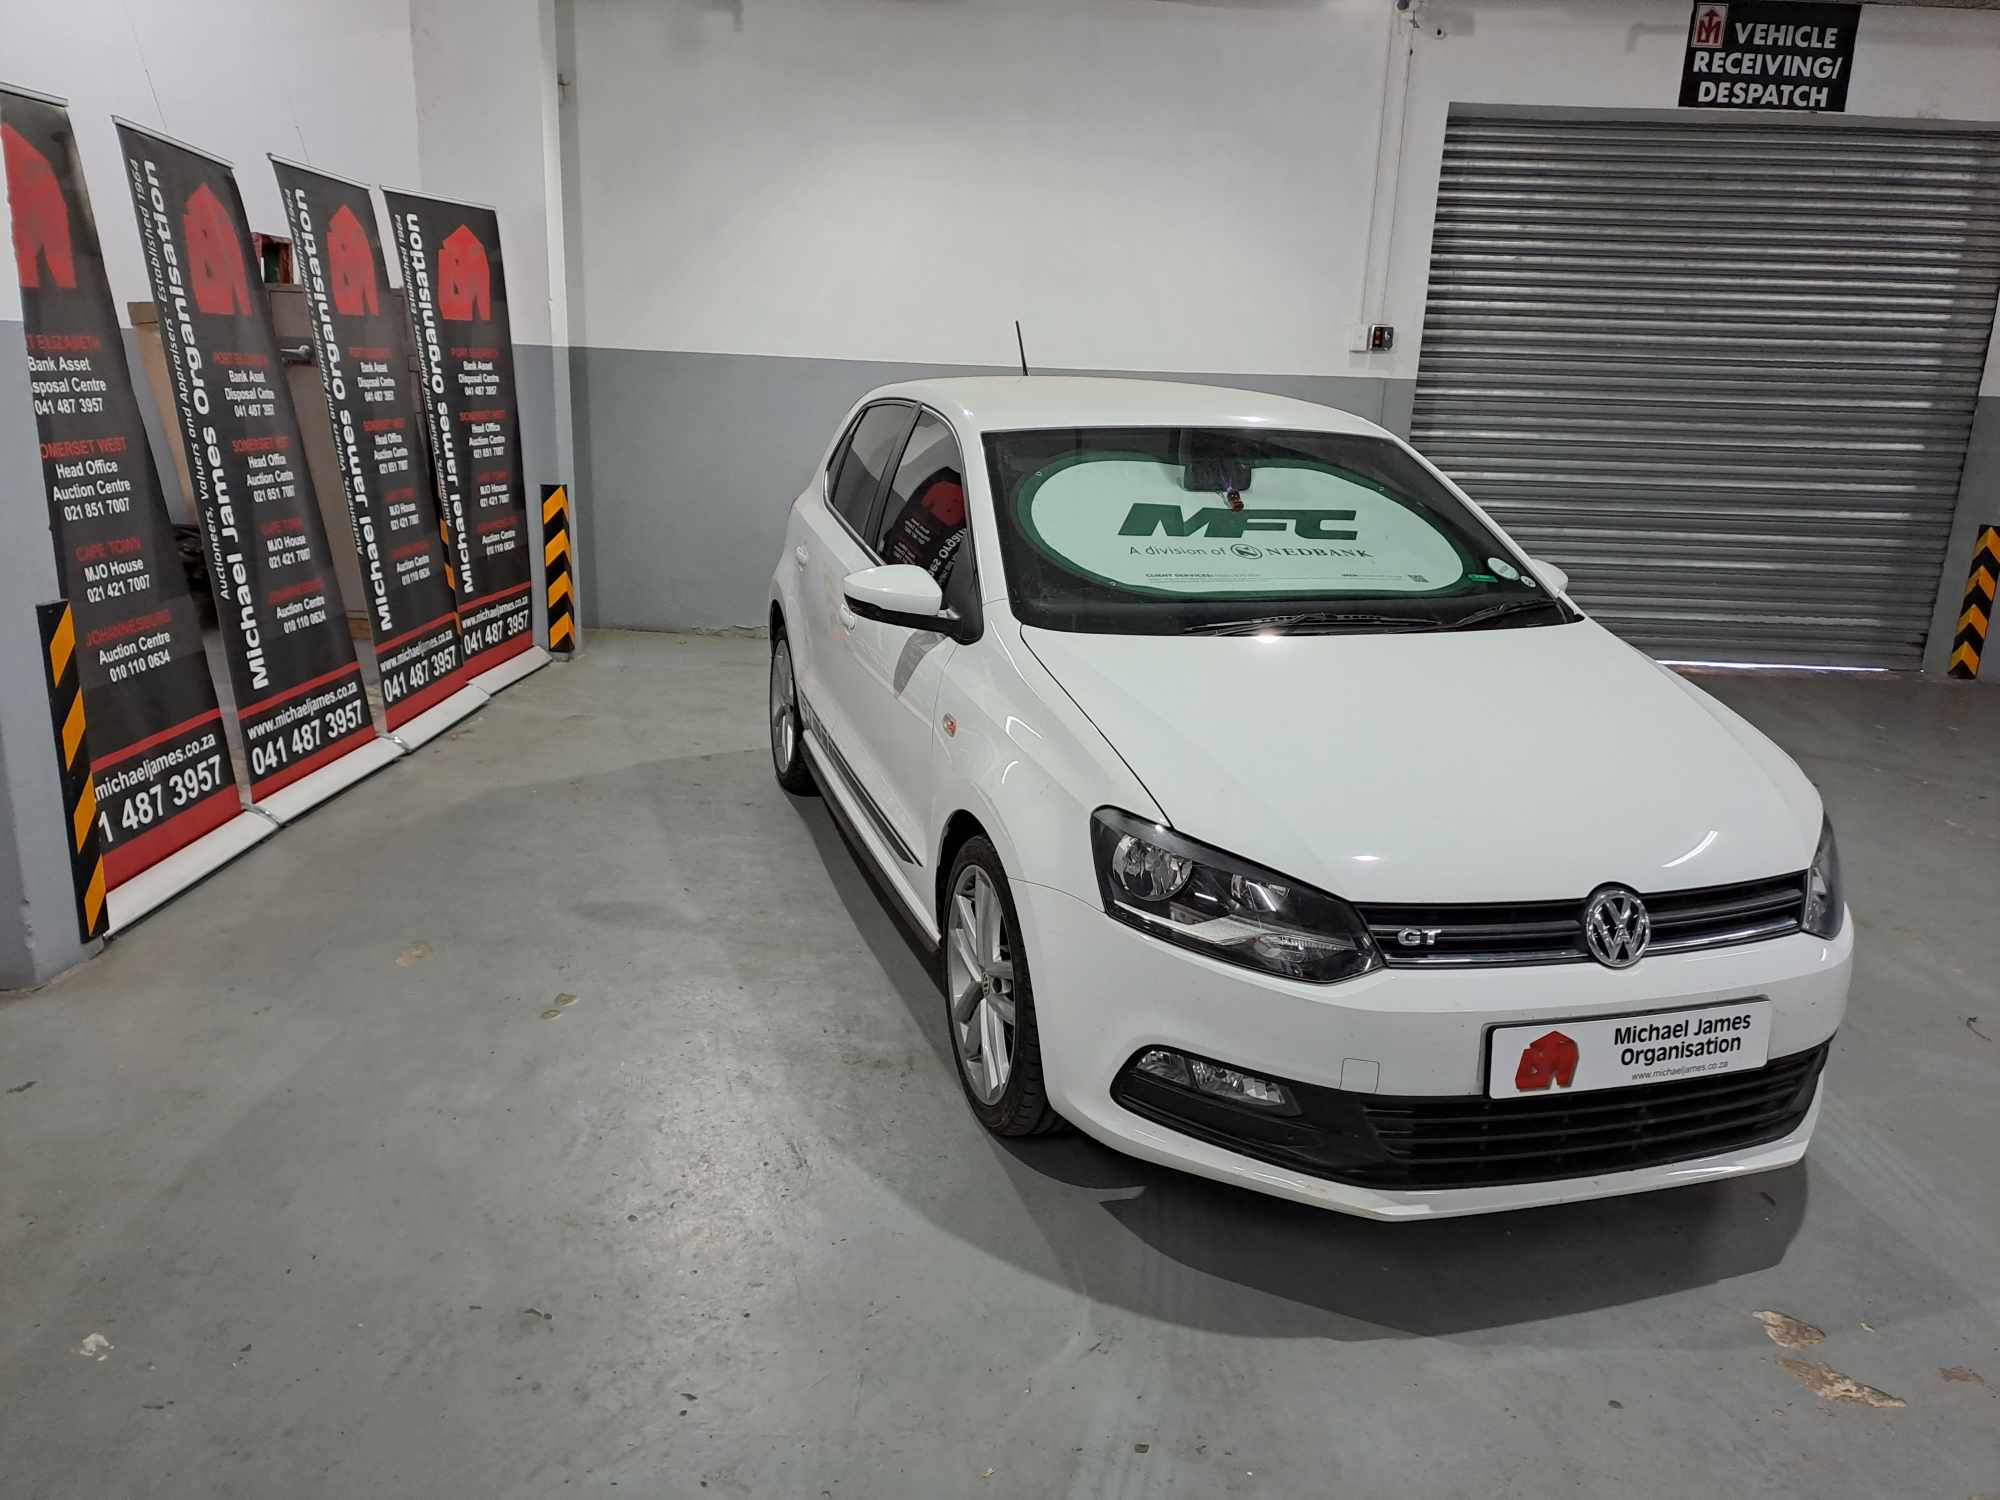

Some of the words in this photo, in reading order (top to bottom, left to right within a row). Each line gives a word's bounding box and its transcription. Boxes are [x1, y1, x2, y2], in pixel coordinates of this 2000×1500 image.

[1735, 22, 1839, 49] VEHICLE
[1692, 51, 1843, 80] RECEIVING/
[1697, 81, 1829, 108] DESPATCH
[129, 158, 146, 201] 1964
[139, 205, 167, 303] Established
[143, 159, 210, 415] Organisation
[295, 188, 346, 400] Organisation
[406, 213, 444, 394] Organisation
[27, 356, 57, 371] Bank
[60, 357, 91, 371] Asset
[165, 318, 190, 403] Appraisers
[72, 377, 107, 392] Centre
[224, 387, 256, 402] Disposal
[35, 400, 54, 415] 041
[57, 399, 76, 413] 487
[79, 398, 104, 413] 3957
[182, 406, 197, 437] and
[340, 410, 368, 508] James
[437, 402, 459, 487] James
[56, 462, 84, 479] Head
[86, 459, 118, 475] Office
[192, 444, 209, 500] Valuers
[202, 426, 239, 543] James
[247, 472, 274, 486] Auction
[53, 484, 95, 501] Auction
[97, 479, 131, 495] Centre
[64, 504, 83, 521] 021
[85, 501, 105, 518] 851
[106, 498, 130, 514] 7007
[1117, 502, 1358, 541] MFC
[205, 507, 231, 600] Auctioneers,
[284, 535, 306, 548] House
[449, 494, 474, 593] Michael
[1129, 546, 1141, 556] A
[1145, 545, 1207, 556] division
[1211, 545, 1227, 556] of
[1265, 547, 1374, 559] NEDBANK
[84, 563, 108, 582] MJO
[111, 559, 144, 574] House
[359, 516, 392, 631] Michael
[87, 586, 105, 603] 021
[107, 580, 127, 598] 421
[128, 574, 150, 592] 7007
[226, 553, 270, 691] Michael
[276, 602, 303, 619] Auction
[99, 641, 138, 665] Auction
[139, 631, 171, 651] Centre
[463, 629, 483, 655] 041
[484, 620, 503, 645] 487
[506, 610, 529, 636] 3957
[110, 667, 127, 682] 010
[129, 659, 146, 676] 110
[148, 650, 171, 669] 0634
[384, 672, 407, 702] 041
[409, 660, 429, 688] 487
[431, 645, 456, 676] 3957
[247, 682, 358, 740] www.michaeljames.co.za
[251, 736, 287, 775] 041
[292, 719, 321, 754] 487
[325, 699, 363, 738] 3957
[95, 733, 217, 800] michaeljames.co.za
[121, 784, 164, 830] 487
[168, 754, 221, 806] 3957
[1397, 927, 1442, 946] GT
[1614, 1020, 1689, 1046] Michael
[1693, 1014, 1751, 1036] James
[1620, 1034, 1741, 1067] Organisation
[1631, 1060, 1729, 1081] www.michaeljames.co.za
